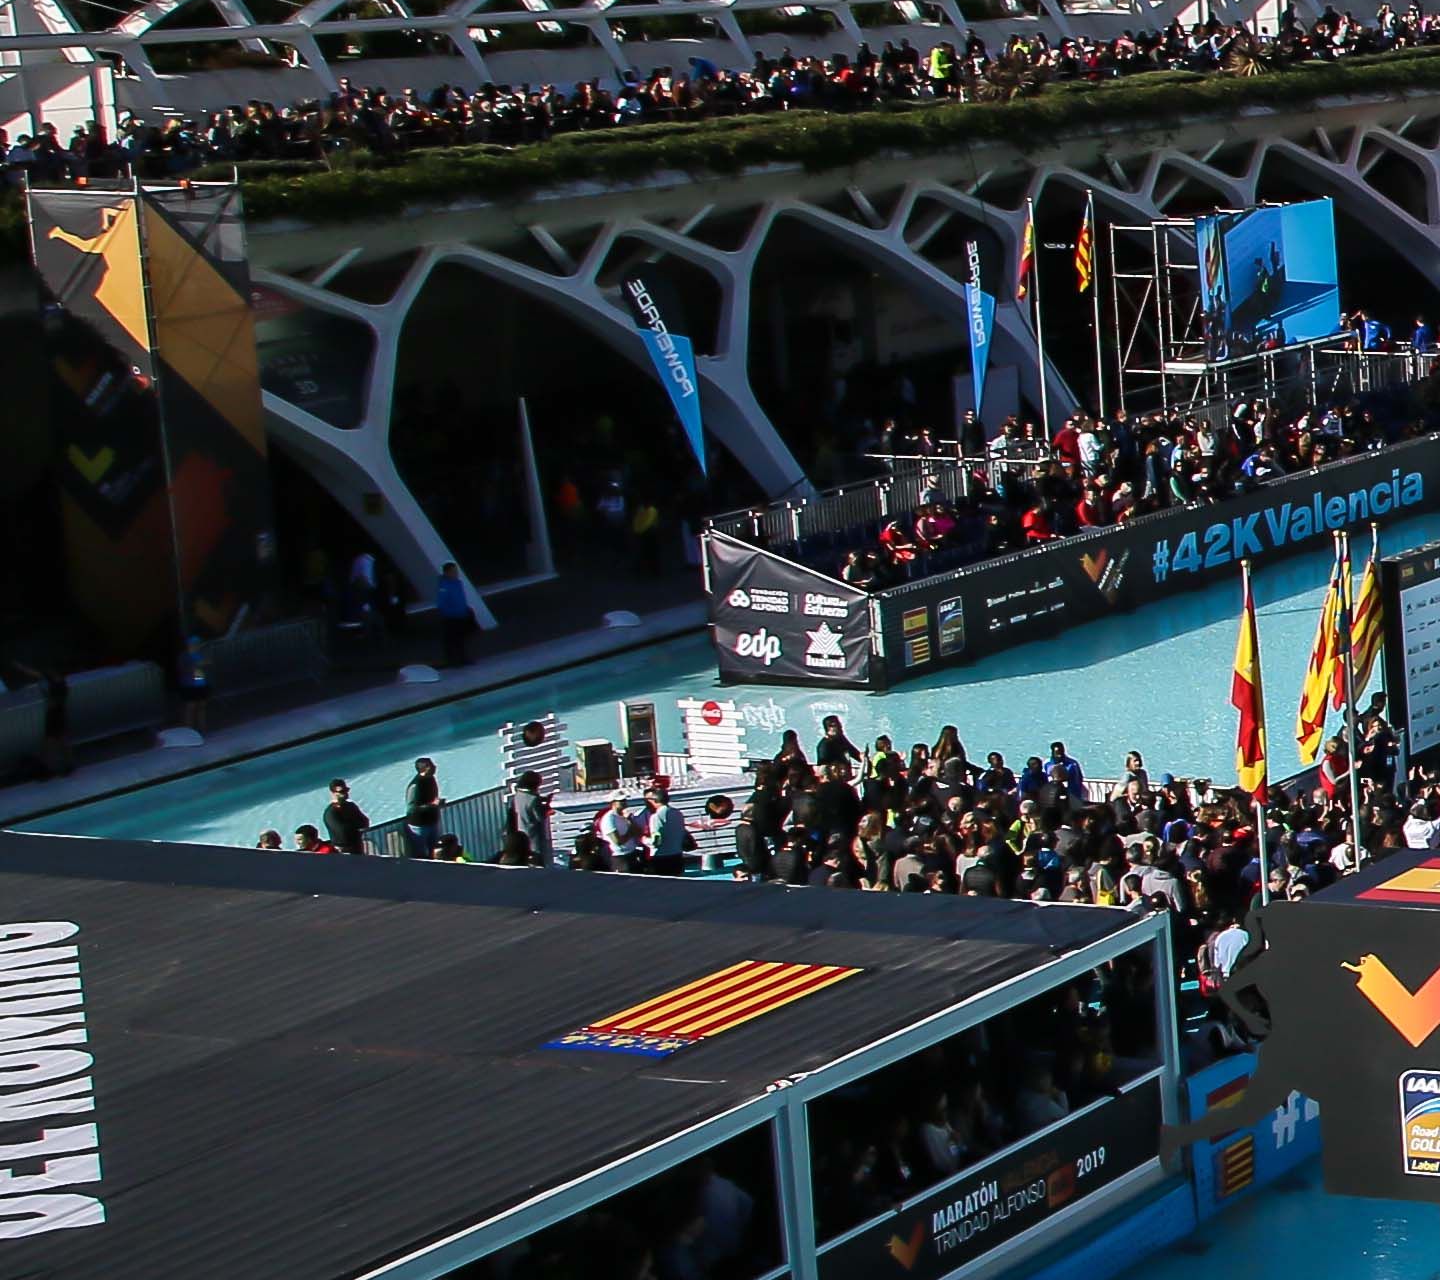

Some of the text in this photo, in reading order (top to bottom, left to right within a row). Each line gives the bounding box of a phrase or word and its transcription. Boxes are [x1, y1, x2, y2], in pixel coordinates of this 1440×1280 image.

[735, 627, 782, 666] edp
[805, 655, 846, 669] luanvi
[1411, 1125, 1440, 1139] Road
[1411, 1159, 1440, 1171] Label
[932, 1179, 998, 1234] MARATÓN
[934, 1145, 1106, 1256] TRINIDAD ALFONSO 2019
